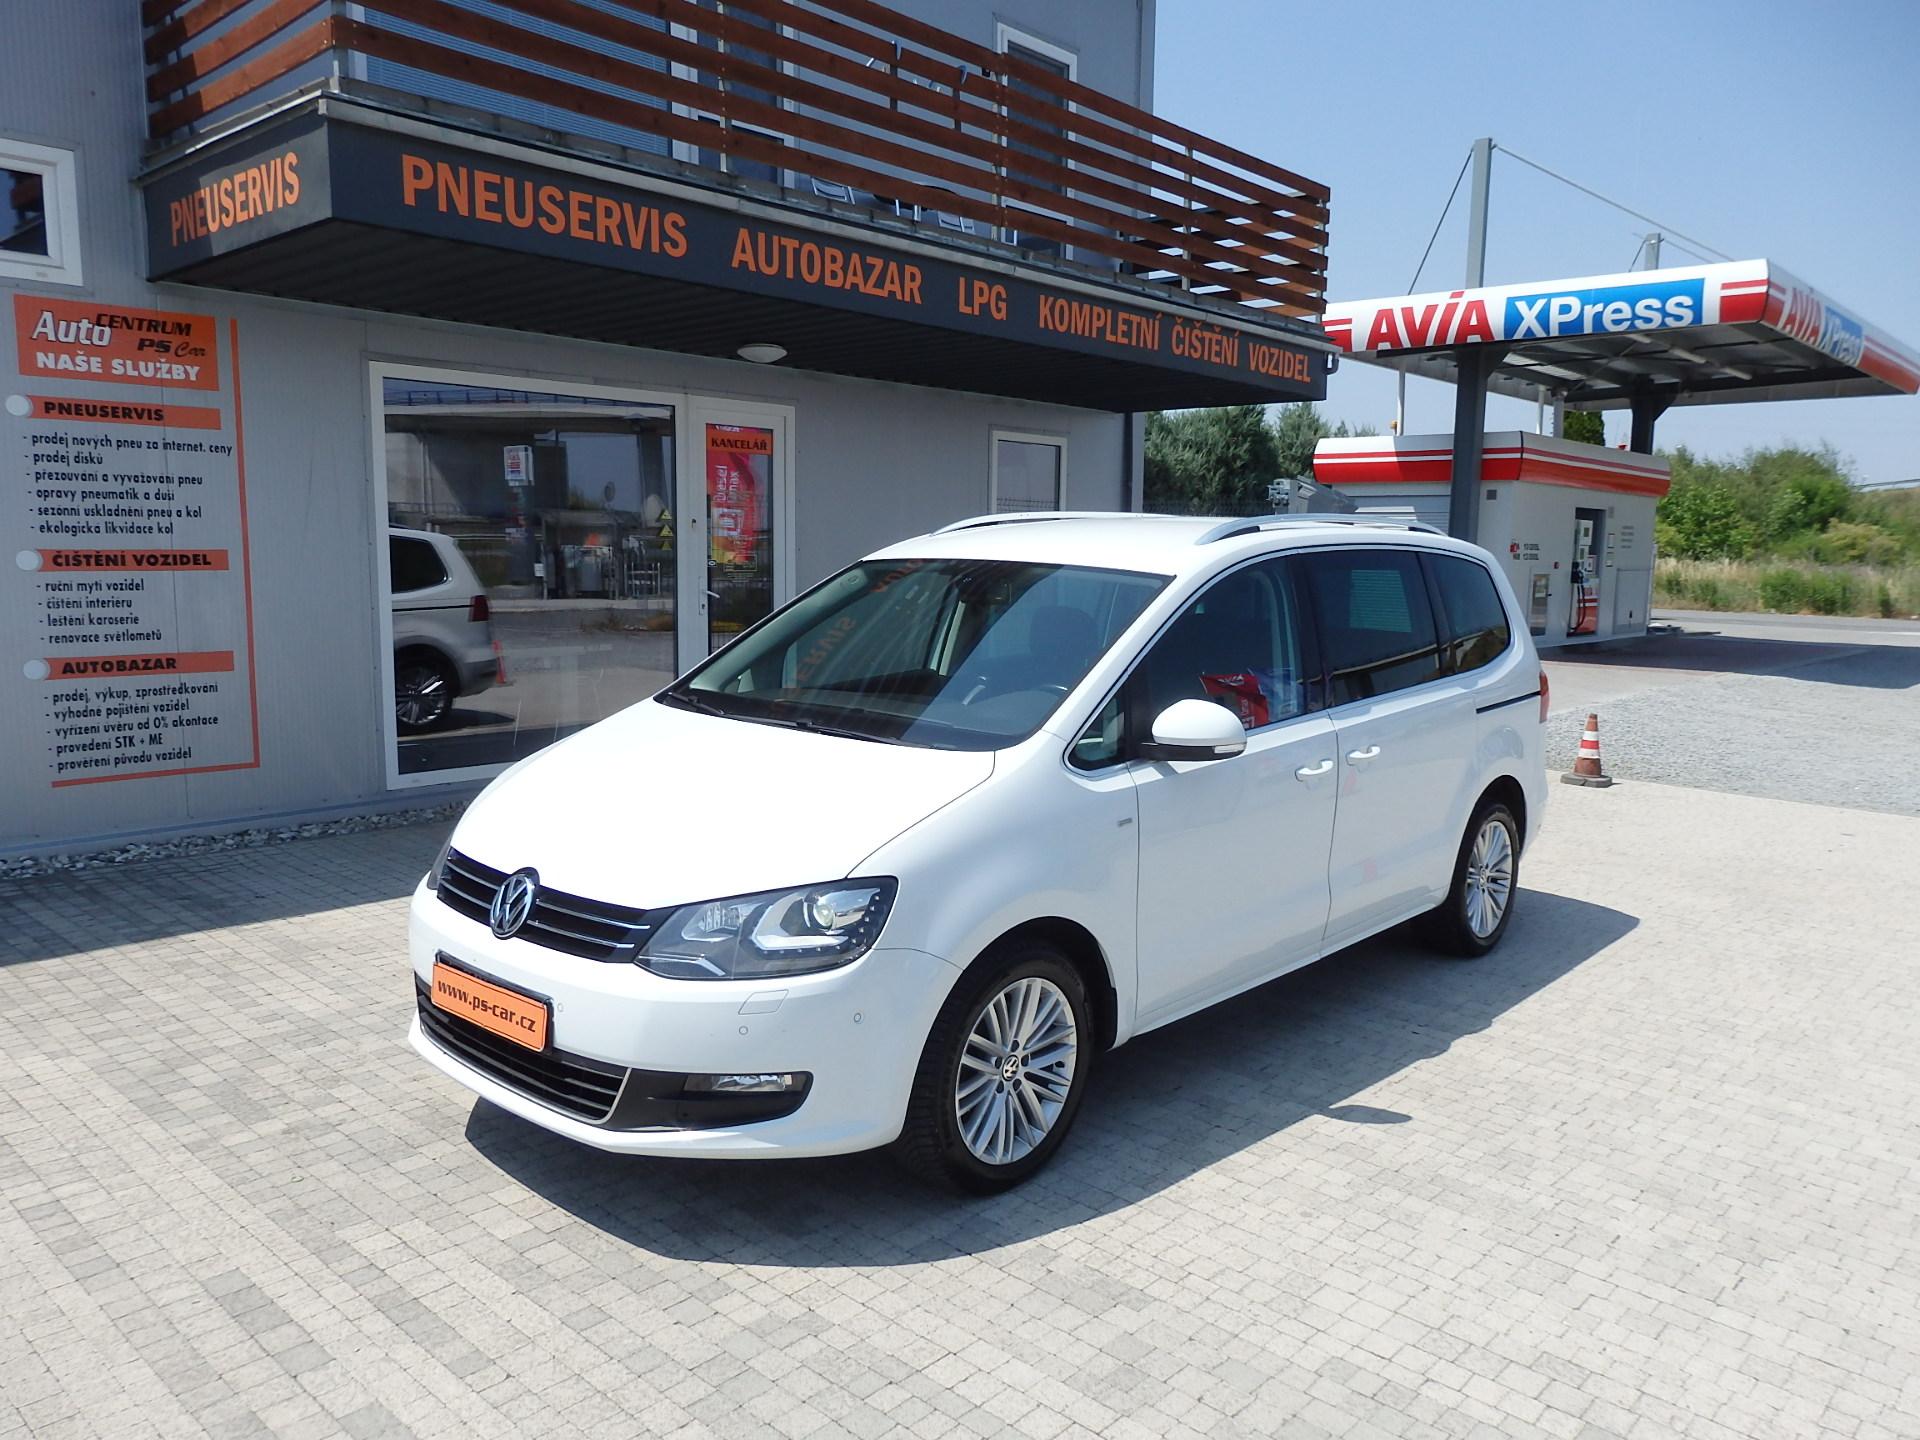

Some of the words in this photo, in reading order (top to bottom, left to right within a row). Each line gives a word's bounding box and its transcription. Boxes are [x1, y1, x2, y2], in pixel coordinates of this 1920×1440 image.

[169, 150, 300, 247] PNEUSERVIS
[402, 153, 688, 258] PNEUSERVIS
[731, 227, 922, 304] AUTOBAZAR
[957, 276, 1007, 320] LPG
[1039, 293, 1163, 351] KOMPLETNÍ
[1171, 316, 1240, 367] ČIŠTĚNÍ
[1248, 342, 1311, 383] VOZIDEL
[1513, 294, 1694, 339] XPress
[32, 309, 112, 347] Auto
[96, 313, 192, 337] CENTRUM
[137, 337, 173, 354] PS
[174, 341, 206, 358] Car
[35, 350, 103, 374] NAŠE
[111, 358, 201, 381] SLUŽBY
[44, 401, 164, 421] PNEUSERVIS
[32, 432, 69, 448] prodej
[72, 433, 112, 450] nových
[116, 439, 142, 451] pneu
[146, 440, 159, 450] za
[162, 437, 206, 453] internet.
[209, 444, 233, 457] ceny
[711, 437, 768, 451] KANCELÁŘ
[33, 450, 70, 467] prodej
[73, 451, 103, 465] disků
[35, 468, 98, 483] přezouvání
[102, 473, 109, 482] a
[112, 471, 175, 486] vyvažování
[178, 476, 203, 488] pneu
[36, 489, 77, 502] opravy
[81, 487, 139, 502] pneumatik
[144, 491, 150, 500] a
[154, 488, 175, 501] duší
[84, 504, 144, 517] uskladnění
[146, 508, 172, 520] pneu
[176, 509, 182, 518] a
[186, 505, 202, 518] kol
[39, 520, 101, 537] ekologická
[104, 521, 154, 534] likvidace
[157, 521, 173, 534] kol
[52, 550, 126, 567] ČIŠTĚNÍ
[132, 553, 212, 566] VOZIDEL
[45, 580, 73, 592] ruční
[106, 578, 144, 591] vozidel
[46, 596, 83, 609] čištění
[86, 595, 133, 609] interiéru
[47, 613, 84, 626] leštění
[88, 612, 140, 626] karoserie
[49, 633, 100, 644] renovace
[104, 628, 162, 642] světlometů
[62, 657, 177, 674] AUTOBAZAR
[53, 688, 91, 706] prodej,
[95, 686, 132, 703] výkup,
[106, 702, 150, 719] pojištění
[153, 697, 189, 713] vozidel
[55, 721, 100, 740] vyřízení
[137, 717, 150, 730] od
[153, 715, 168, 729] 0%
[172, 714, 219, 728] akontace
[56, 738, 112, 758] provedení
[115, 734, 136, 749] STK
[149, 732, 163, 746] ME
[114, 750, 152, 768] původu
[155, 746, 192, 761] vozidel
[437, 980, 536, 1032] www.ps-car.cz
